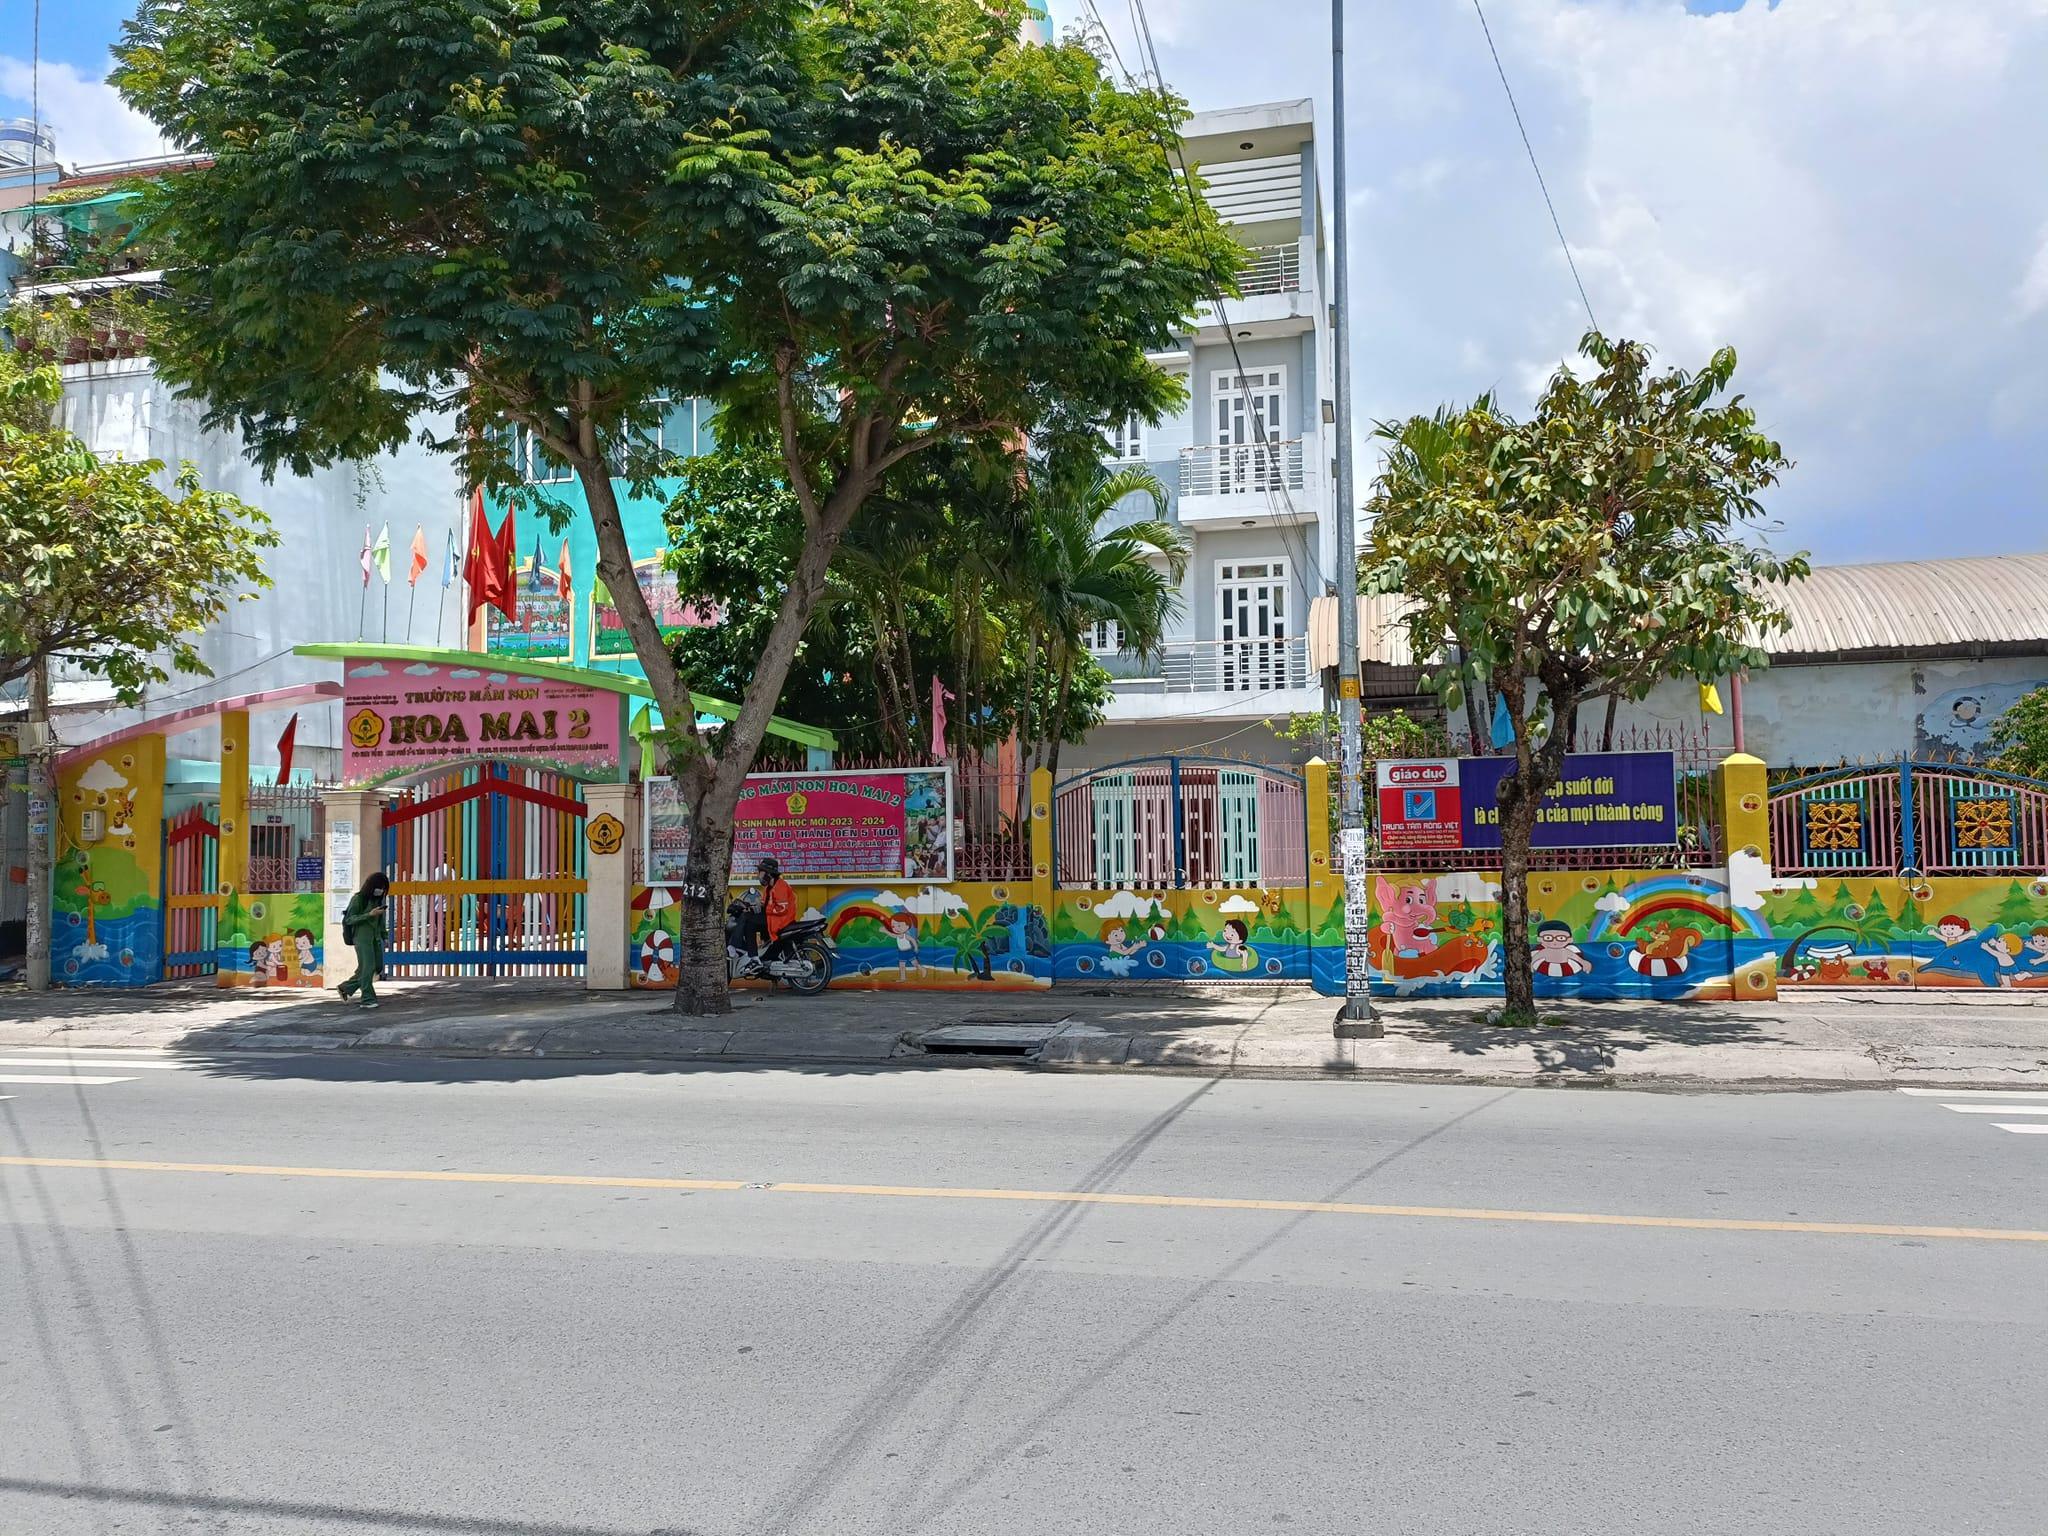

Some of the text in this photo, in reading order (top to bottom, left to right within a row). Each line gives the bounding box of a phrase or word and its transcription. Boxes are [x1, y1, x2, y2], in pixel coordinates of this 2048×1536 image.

[405, 686, 466, 704] TRƯỜNG
[469, 683, 505, 702] MẦM
[508, 687, 539, 701] NON
[389, 708, 591, 745] HOA MAI 2
[1391, 768, 1445, 781] giáo dục
[758, 779, 792, 797] MẦM
[795, 780, 826, 792] NON
[828, 780, 859, 795] HOA
[861, 785, 890, 803] MAI
[889, 794, 901, 807] 2
[1565, 776, 1593, 795] suốt
[1594, 776, 1614, 794] đời
[742, 819, 763, 828] SINH
[765, 818, 786, 827] NĂM
[788, 818, 807, 828] HỌC
[810, 817, 828, 826] MỚI
[830, 817, 853, 826] 2023
[862, 816, 885, 826] 2024
[1474, 806, 1486, 824] là
[1546, 802, 1568, 823] của
[1571, 804, 1594, 825] mọi
[1595, 803, 1631, 822] thành
[1632, 802, 1664, 822] công
[736, 828, 757, 839] TRẺ
[761, 828, 776, 839] TỪ
[795, 827, 832, 839] THÁNG
[861, 828, 869, 837] 5
[683, 883, 706, 898] 212
